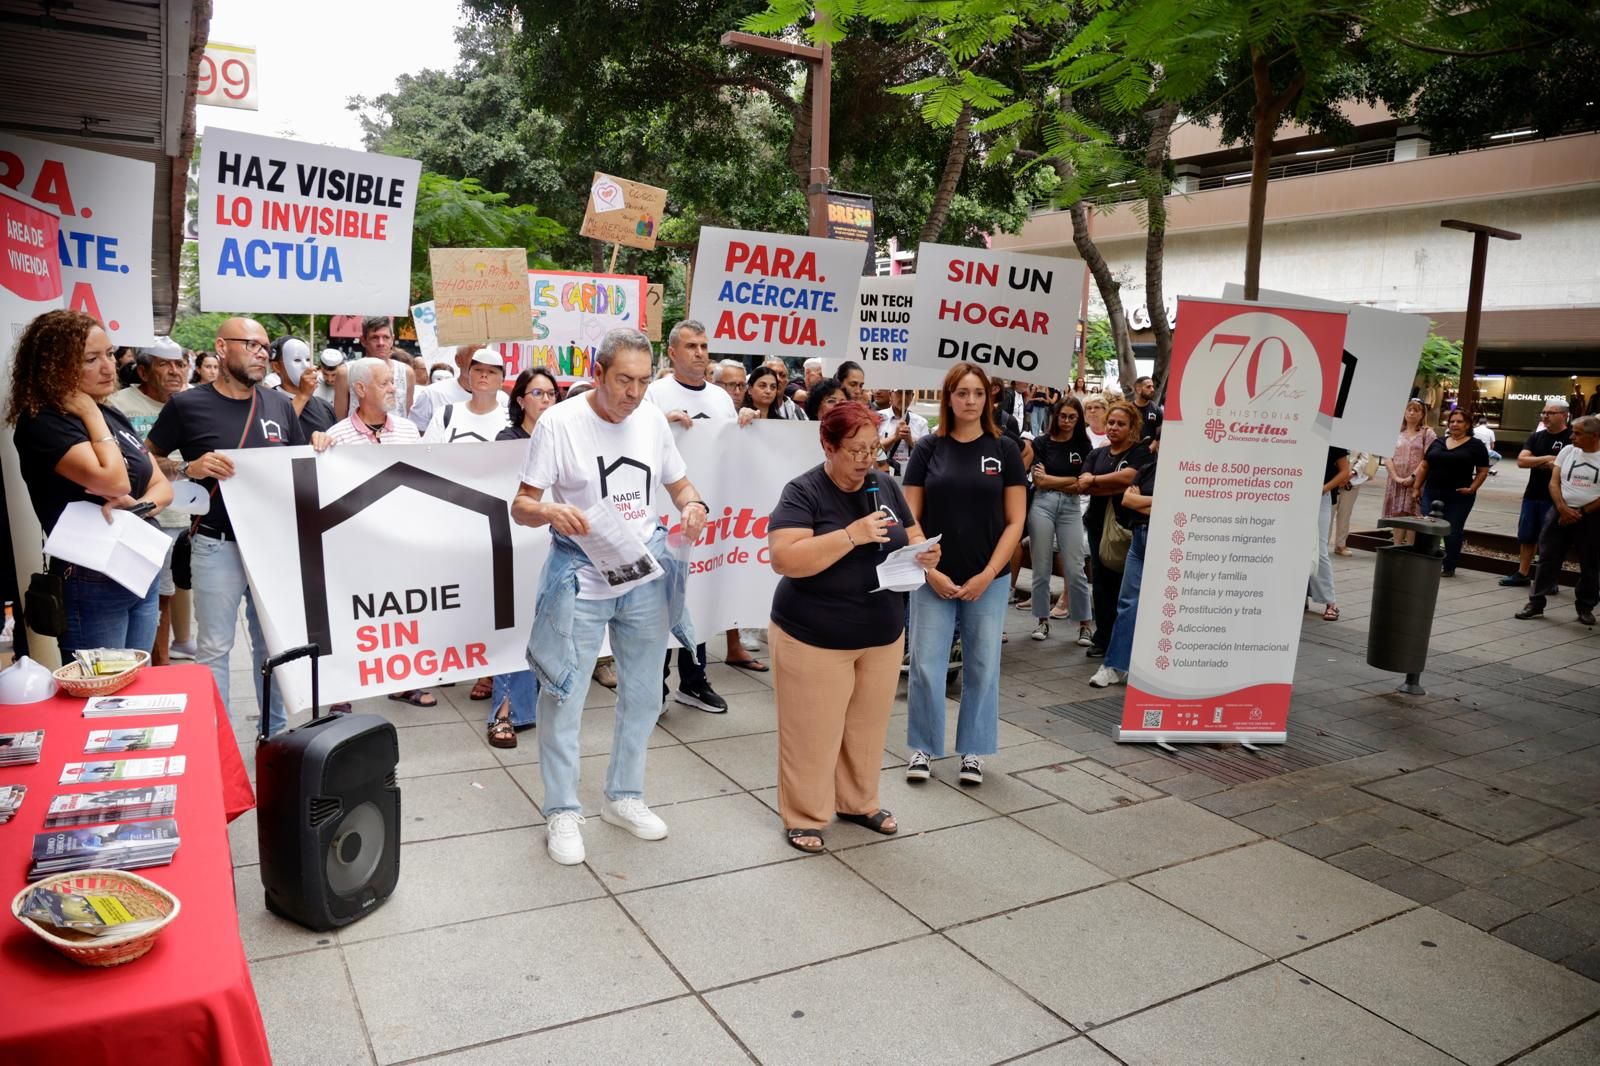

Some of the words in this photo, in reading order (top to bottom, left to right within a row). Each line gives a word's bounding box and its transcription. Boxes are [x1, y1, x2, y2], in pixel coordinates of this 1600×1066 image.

[217, 151, 287, 192] HAZ
[296, 163, 405, 208] VISIBLE
[216, 194, 252, 228] LO
[262, 200, 388, 241] INVISIBLE
[7, 213, 32, 243] ÁREA
[32, 229, 45, 248] DE
[8, 248, 50, 277] VIVIENDA
[217, 237, 343, 282] ACTÚA
[724, 240, 826, 283] PARA.
[947, 259, 999, 287] SIN
[1008, 266, 1053, 294] UN
[534, 280, 559, 307] ES
[718, 278, 838, 313] ACÉRCATE.
[860, 293, 878, 306] UN
[882, 294, 913, 308] TECH
[860, 309, 877, 323] UN
[881, 310, 910, 324] LUJO
[938, 298, 1049, 335] HOGAR
[713, 310, 826, 347] ACTÚA.
[860, 327, 909, 344] DEREC
[500, 340, 597, 379] HUMANIDA
[860, 346, 869, 361] Y
[872, 347, 889, 361] ES
[938, 338, 1038, 372] DIGNO
[1210, 333, 1294, 408] 70
[1508, 393, 1542, 401] MICHAEL
[1207, 408, 1224, 417] DE
[1230, 409, 1300, 421] HISTORIAS
[1229, 421, 1289, 436] Cáritas
[1178, 461, 1202, 473] Más
[1204, 462, 1219, 473] de
[1221, 463, 1250, 474] 8.500
[1252, 465, 1304, 477] personas
[1184, 476, 1271, 489] comprometidas
[1273, 480, 1293, 489] con
[612, 490, 641, 503] NADIE
[1184, 489, 1233, 500] nuestros
[1235, 490, 1291, 503] proyectos
[615, 502, 632, 512] SIN
[623, 509, 647, 521] OGAR
[1190, 513, 1233, 525] Personas
[1234, 515, 1249, 525] sin
[1250, 516, 1276, 528] hogar
[1188, 532, 1231, 543] Personas
[1232, 533, 1277, 545] migrantes
[727, 546, 749, 564] de
[1186, 551, 1220, 563] Empleo
[1221, 555, 1227, 564] y
[1229, 553, 1274, 564] formación
[1183, 570, 1209, 581] Mujer
[1218, 571, 1248, 581] familia
[1181, 587, 1216, 597] Infancia
[1218, 590, 1224, 598] y
[1225, 589, 1264, 599] mayores
[352, 584, 461, 620] NADIE
[1178, 604, 1233, 615] Prostitución
[1234, 608, 1240, 616] y
[1241, 606, 1262, 616] trata
[356, 620, 419, 653] SIN
[1176, 624, 1227, 634] Adicciones
[1174, 641, 1232, 652] Cooperación
[1233, 642, 1290, 652] Internacional
[358, 642, 489, 687] HOGAR
[1172, 658, 1229, 668] Voluntariado
